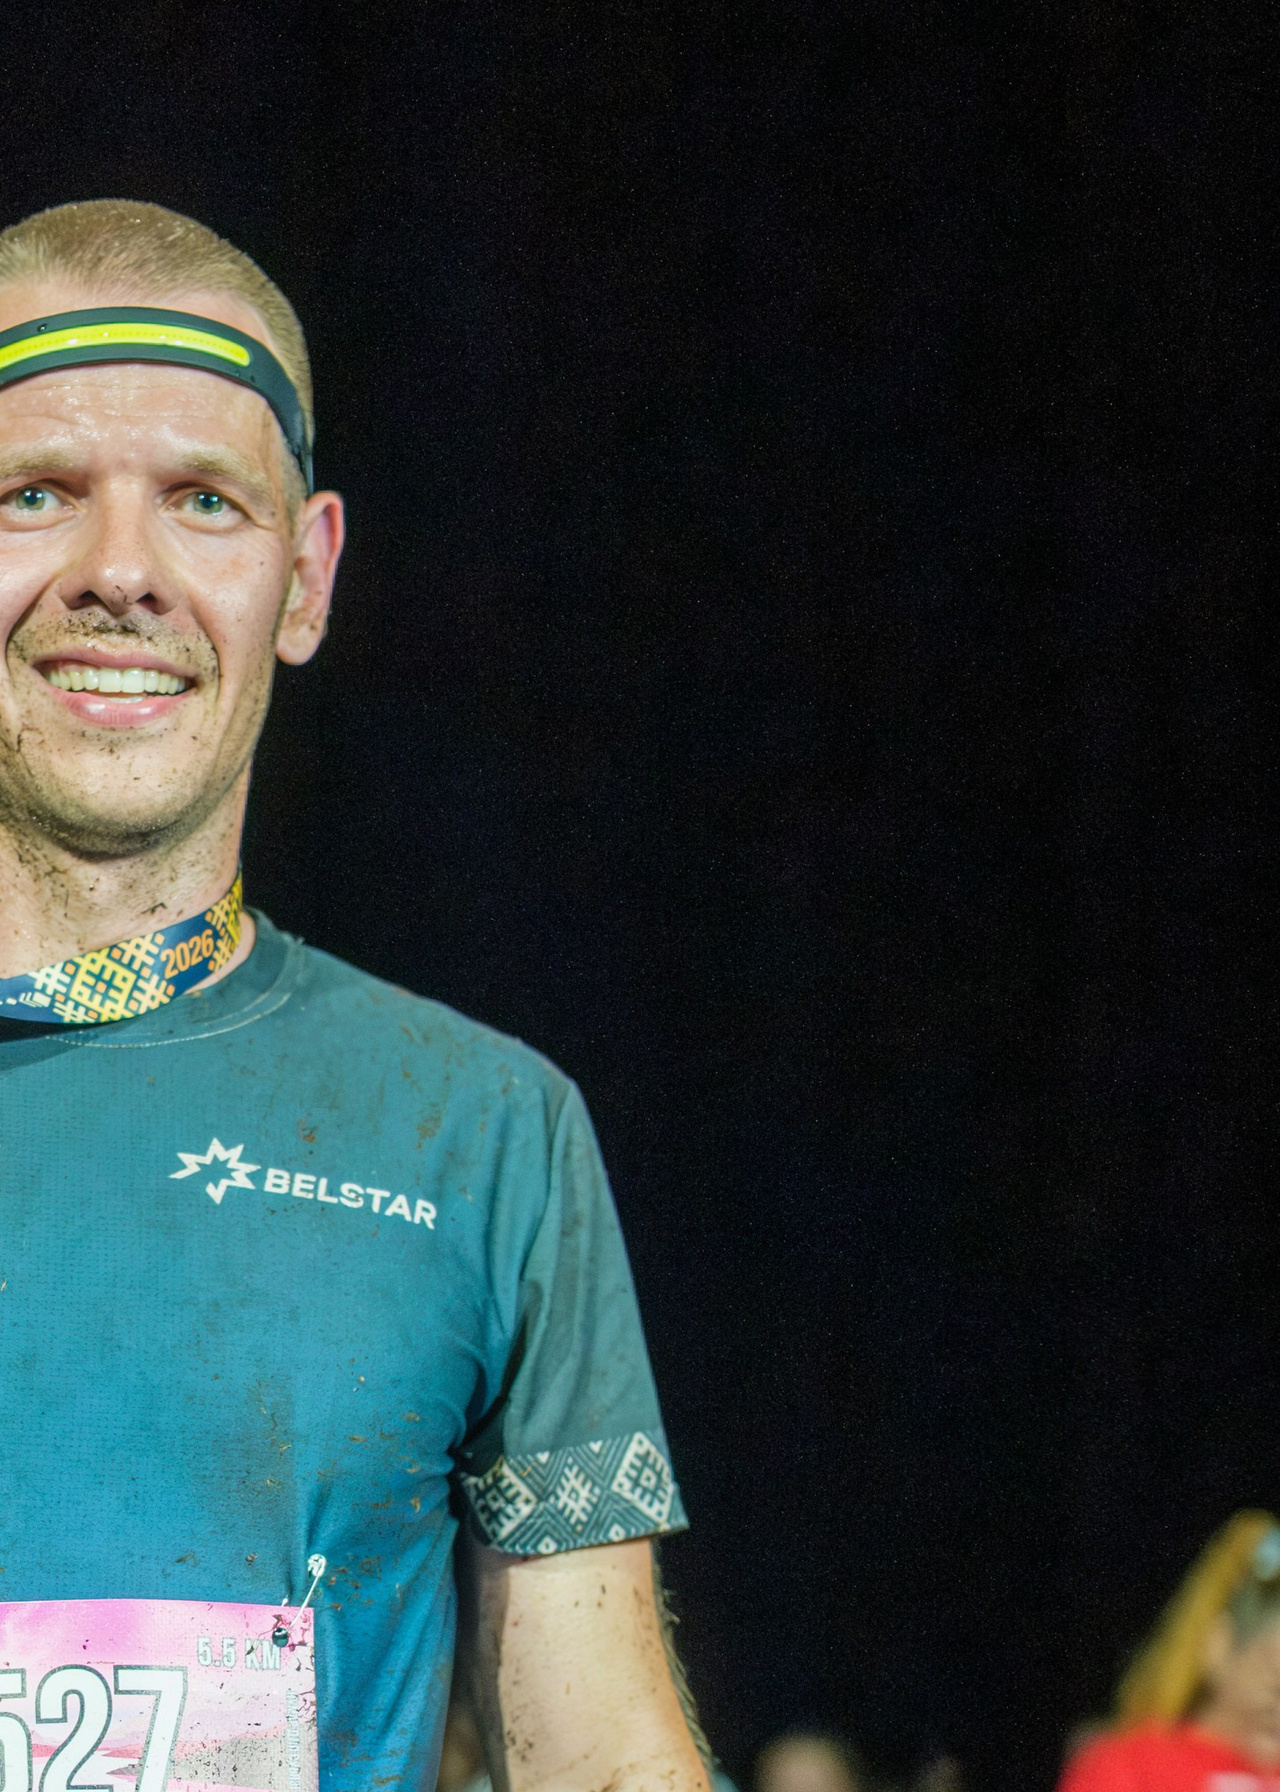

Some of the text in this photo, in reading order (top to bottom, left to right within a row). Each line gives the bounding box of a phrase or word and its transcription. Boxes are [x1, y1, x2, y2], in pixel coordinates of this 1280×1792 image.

[160, 929, 214, 979] 2026
[263, 1168, 437, 1230] BELSTAR
[197, 1635, 237, 1668] 5.5
